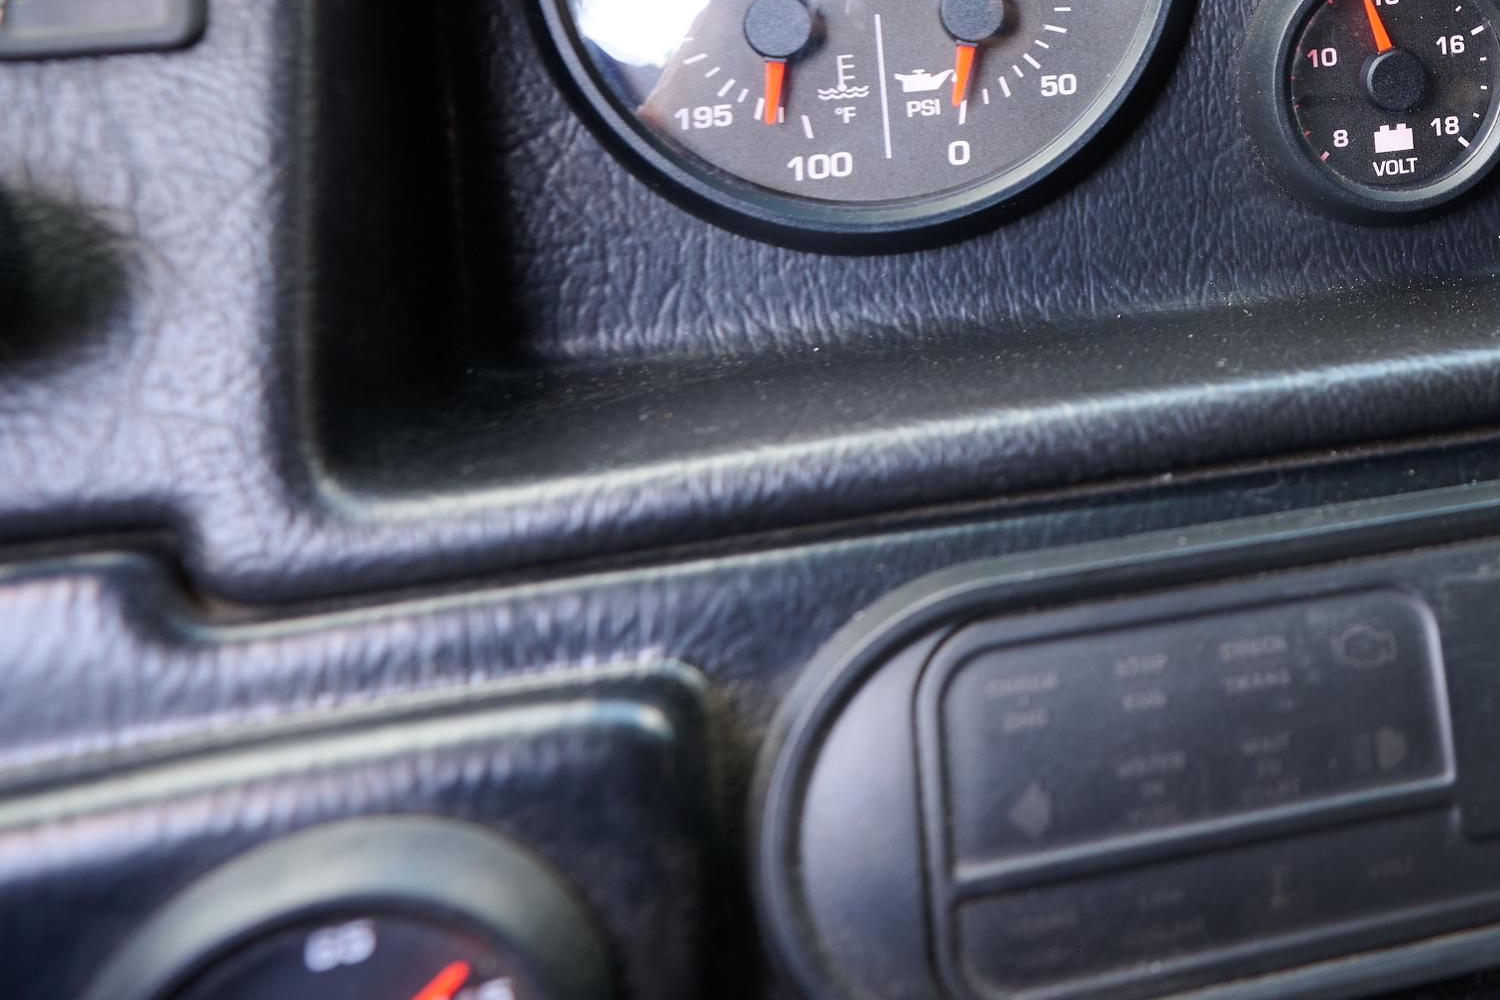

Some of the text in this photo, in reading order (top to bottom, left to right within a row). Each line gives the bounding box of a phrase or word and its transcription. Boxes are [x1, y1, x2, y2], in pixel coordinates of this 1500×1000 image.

[1436, 35, 1465, 55] 16
[1306, 47, 1338, 68] 10
[1040, 74, 1077, 98] 50
[674, 104, 733, 131] 195
[907, 100, 941, 117] PSI
[1430, 115, 1460, 137] 18
[1333, 129, 1349, 148] 8
[948, 140, 970, 166] 0
[786, 152, 853, 182] 100
[1372, 157, 1418, 177] VOLT
